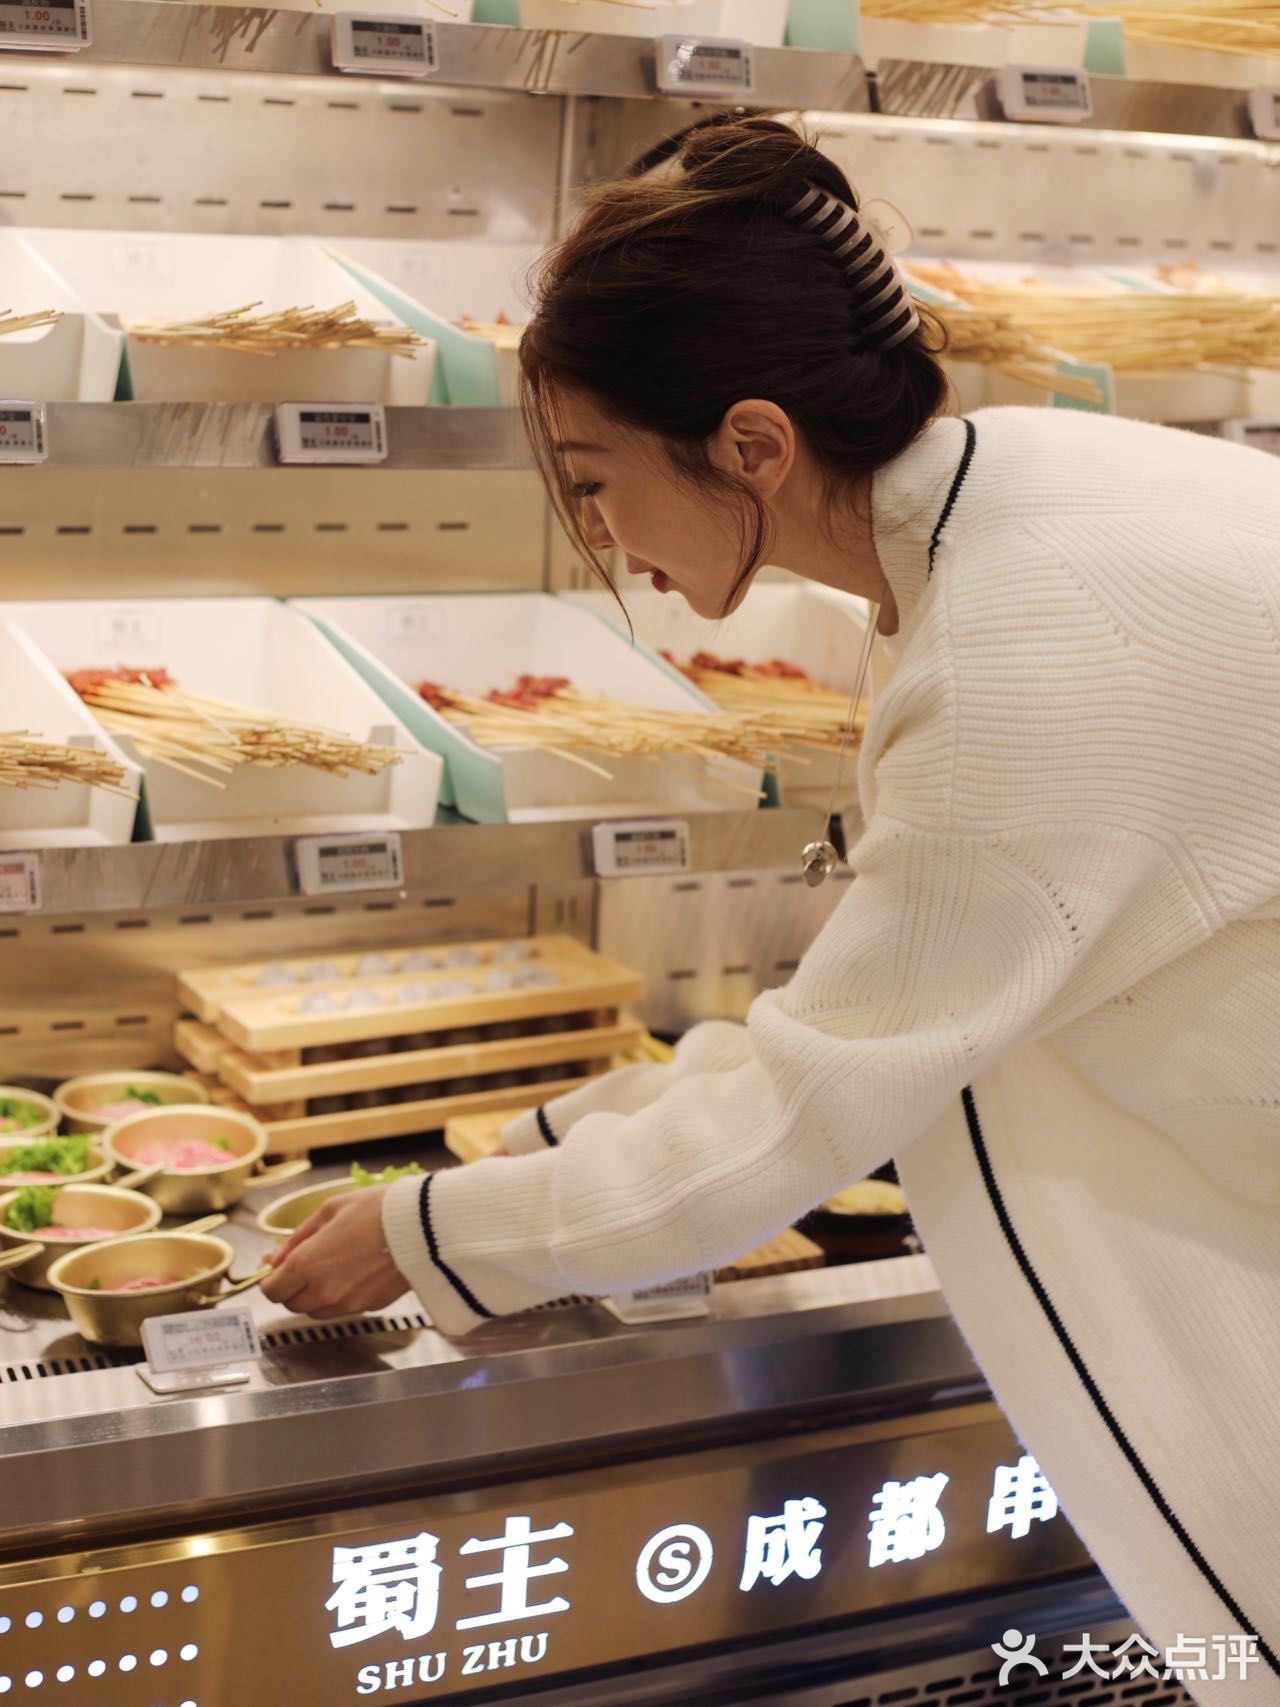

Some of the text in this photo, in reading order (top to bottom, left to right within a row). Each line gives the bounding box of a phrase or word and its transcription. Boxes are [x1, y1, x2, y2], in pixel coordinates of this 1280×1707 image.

[24, 10, 50, 21] 1.00
[325, 1516, 575, 1649] 蜀主
[356, 1632, 548, 1694] SHU ZHU
